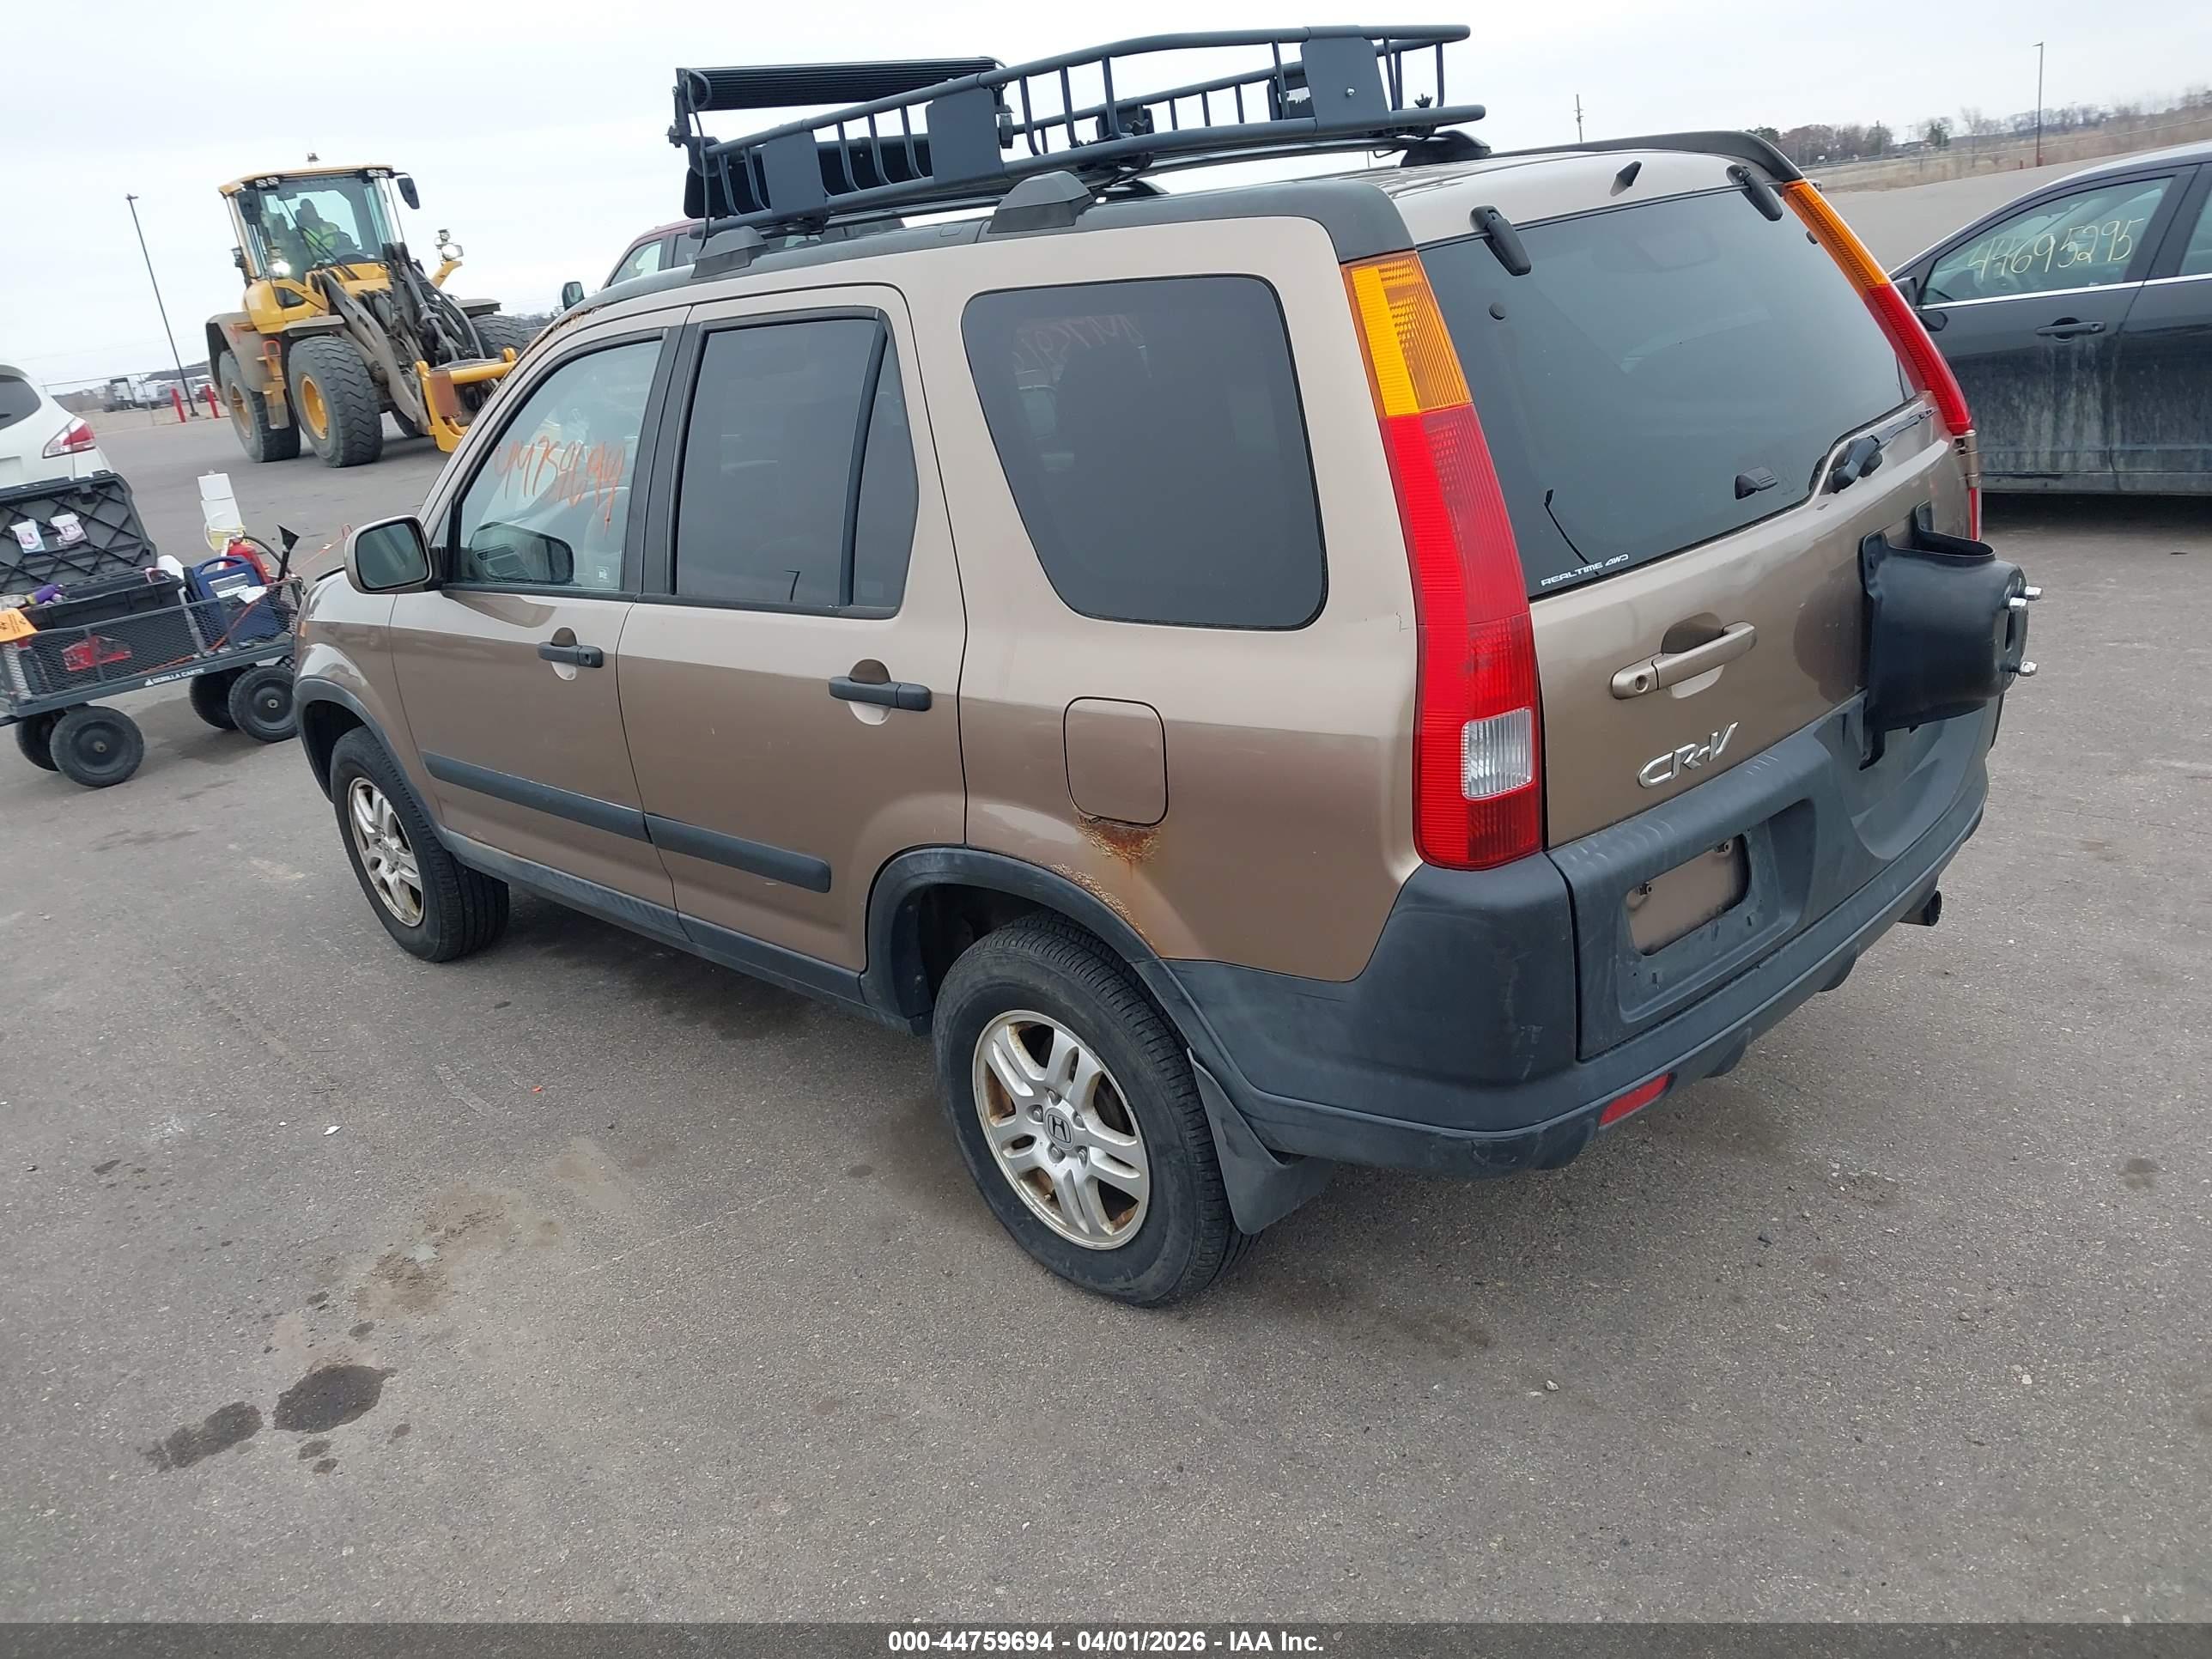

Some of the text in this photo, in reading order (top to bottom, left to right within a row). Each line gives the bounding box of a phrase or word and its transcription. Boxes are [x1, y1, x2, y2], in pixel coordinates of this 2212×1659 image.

[1966, 218, 2146, 281] 44695295
[1540, 562, 1604, 586] REALTIME
[1638, 721, 1739, 788] CR-V
